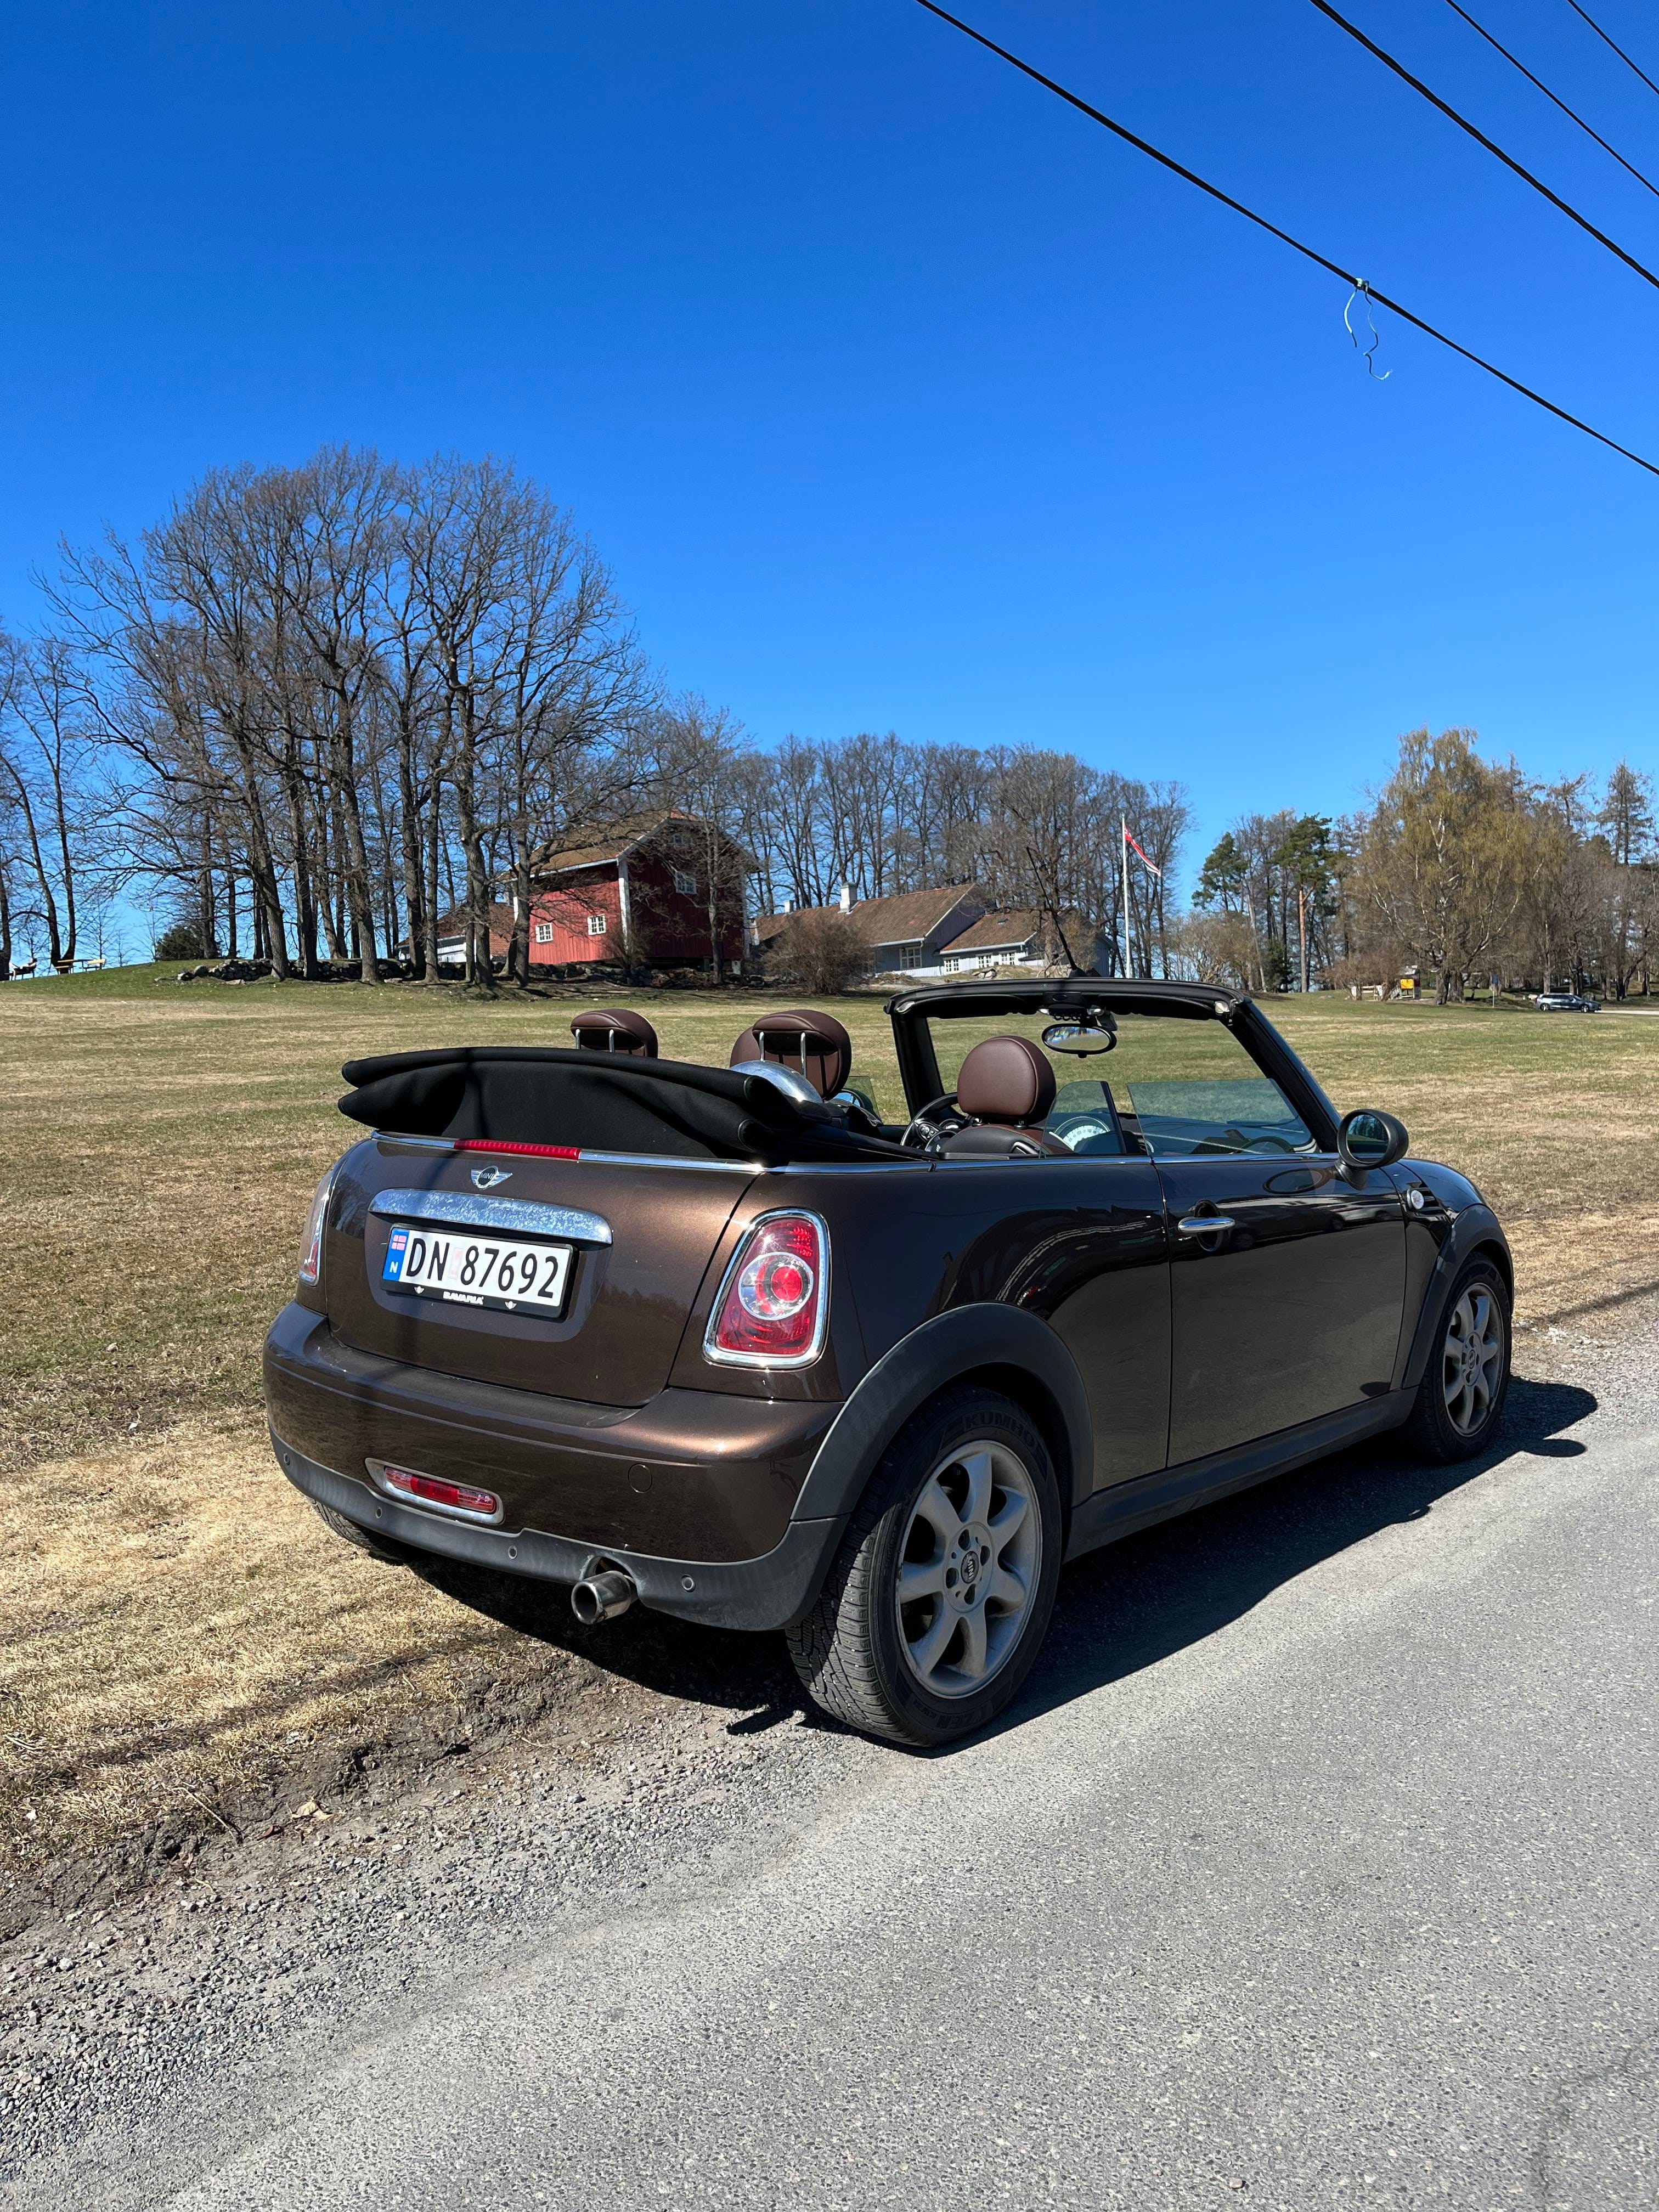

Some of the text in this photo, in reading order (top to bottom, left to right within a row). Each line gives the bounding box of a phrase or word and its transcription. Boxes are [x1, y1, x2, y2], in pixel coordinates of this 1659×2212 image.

[390, 1261, 399, 1273] N
[406, 1238, 558, 1299] DN 87692
[443, 1291, 484, 1305] BAVARIA
[963, 1412, 1036, 1447] KUMHO
